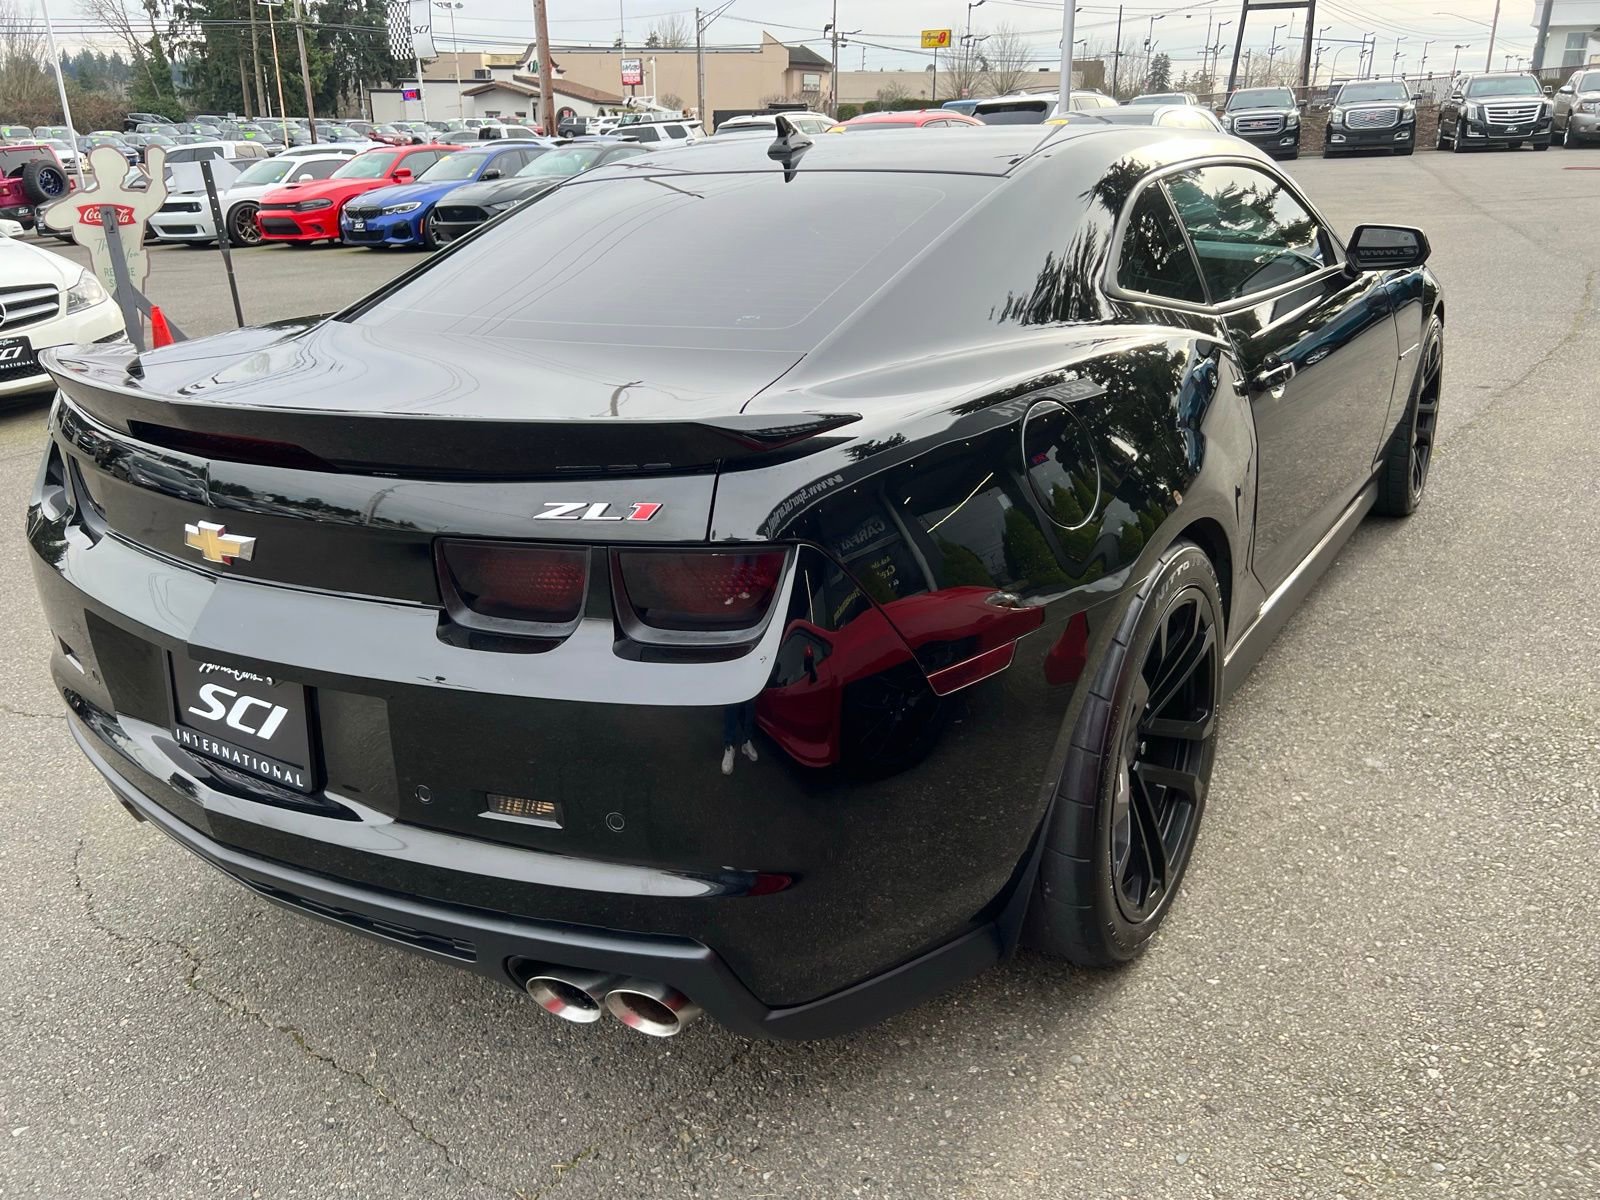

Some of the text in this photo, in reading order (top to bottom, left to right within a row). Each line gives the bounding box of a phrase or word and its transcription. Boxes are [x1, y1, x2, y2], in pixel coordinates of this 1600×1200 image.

[412, 25, 429, 34] SCI
[938, 32, 947, 43] 8
[104, 267, 135, 277] REE
[0, 346, 23, 360] CI
[533, 502, 663, 521] ZL1
[188, 683, 288, 740] SCI
[176, 728, 304, 788] INTERNATIONAL
